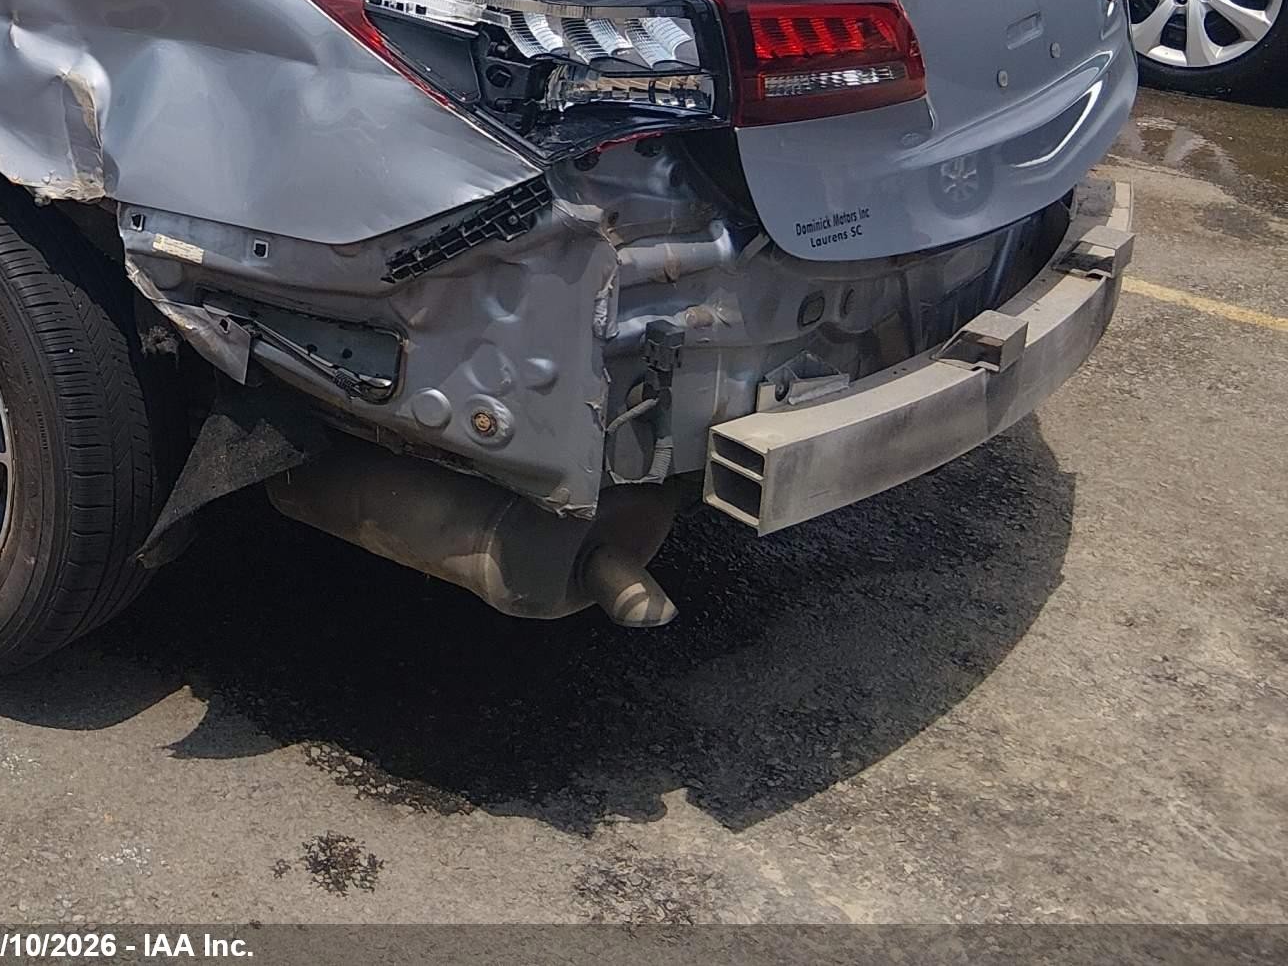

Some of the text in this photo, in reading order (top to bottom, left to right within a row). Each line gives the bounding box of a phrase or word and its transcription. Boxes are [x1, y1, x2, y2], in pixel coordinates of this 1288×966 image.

[795, 208, 870, 236] Dominick Motors Inc
[810, 225, 863, 248] Laurens SC
